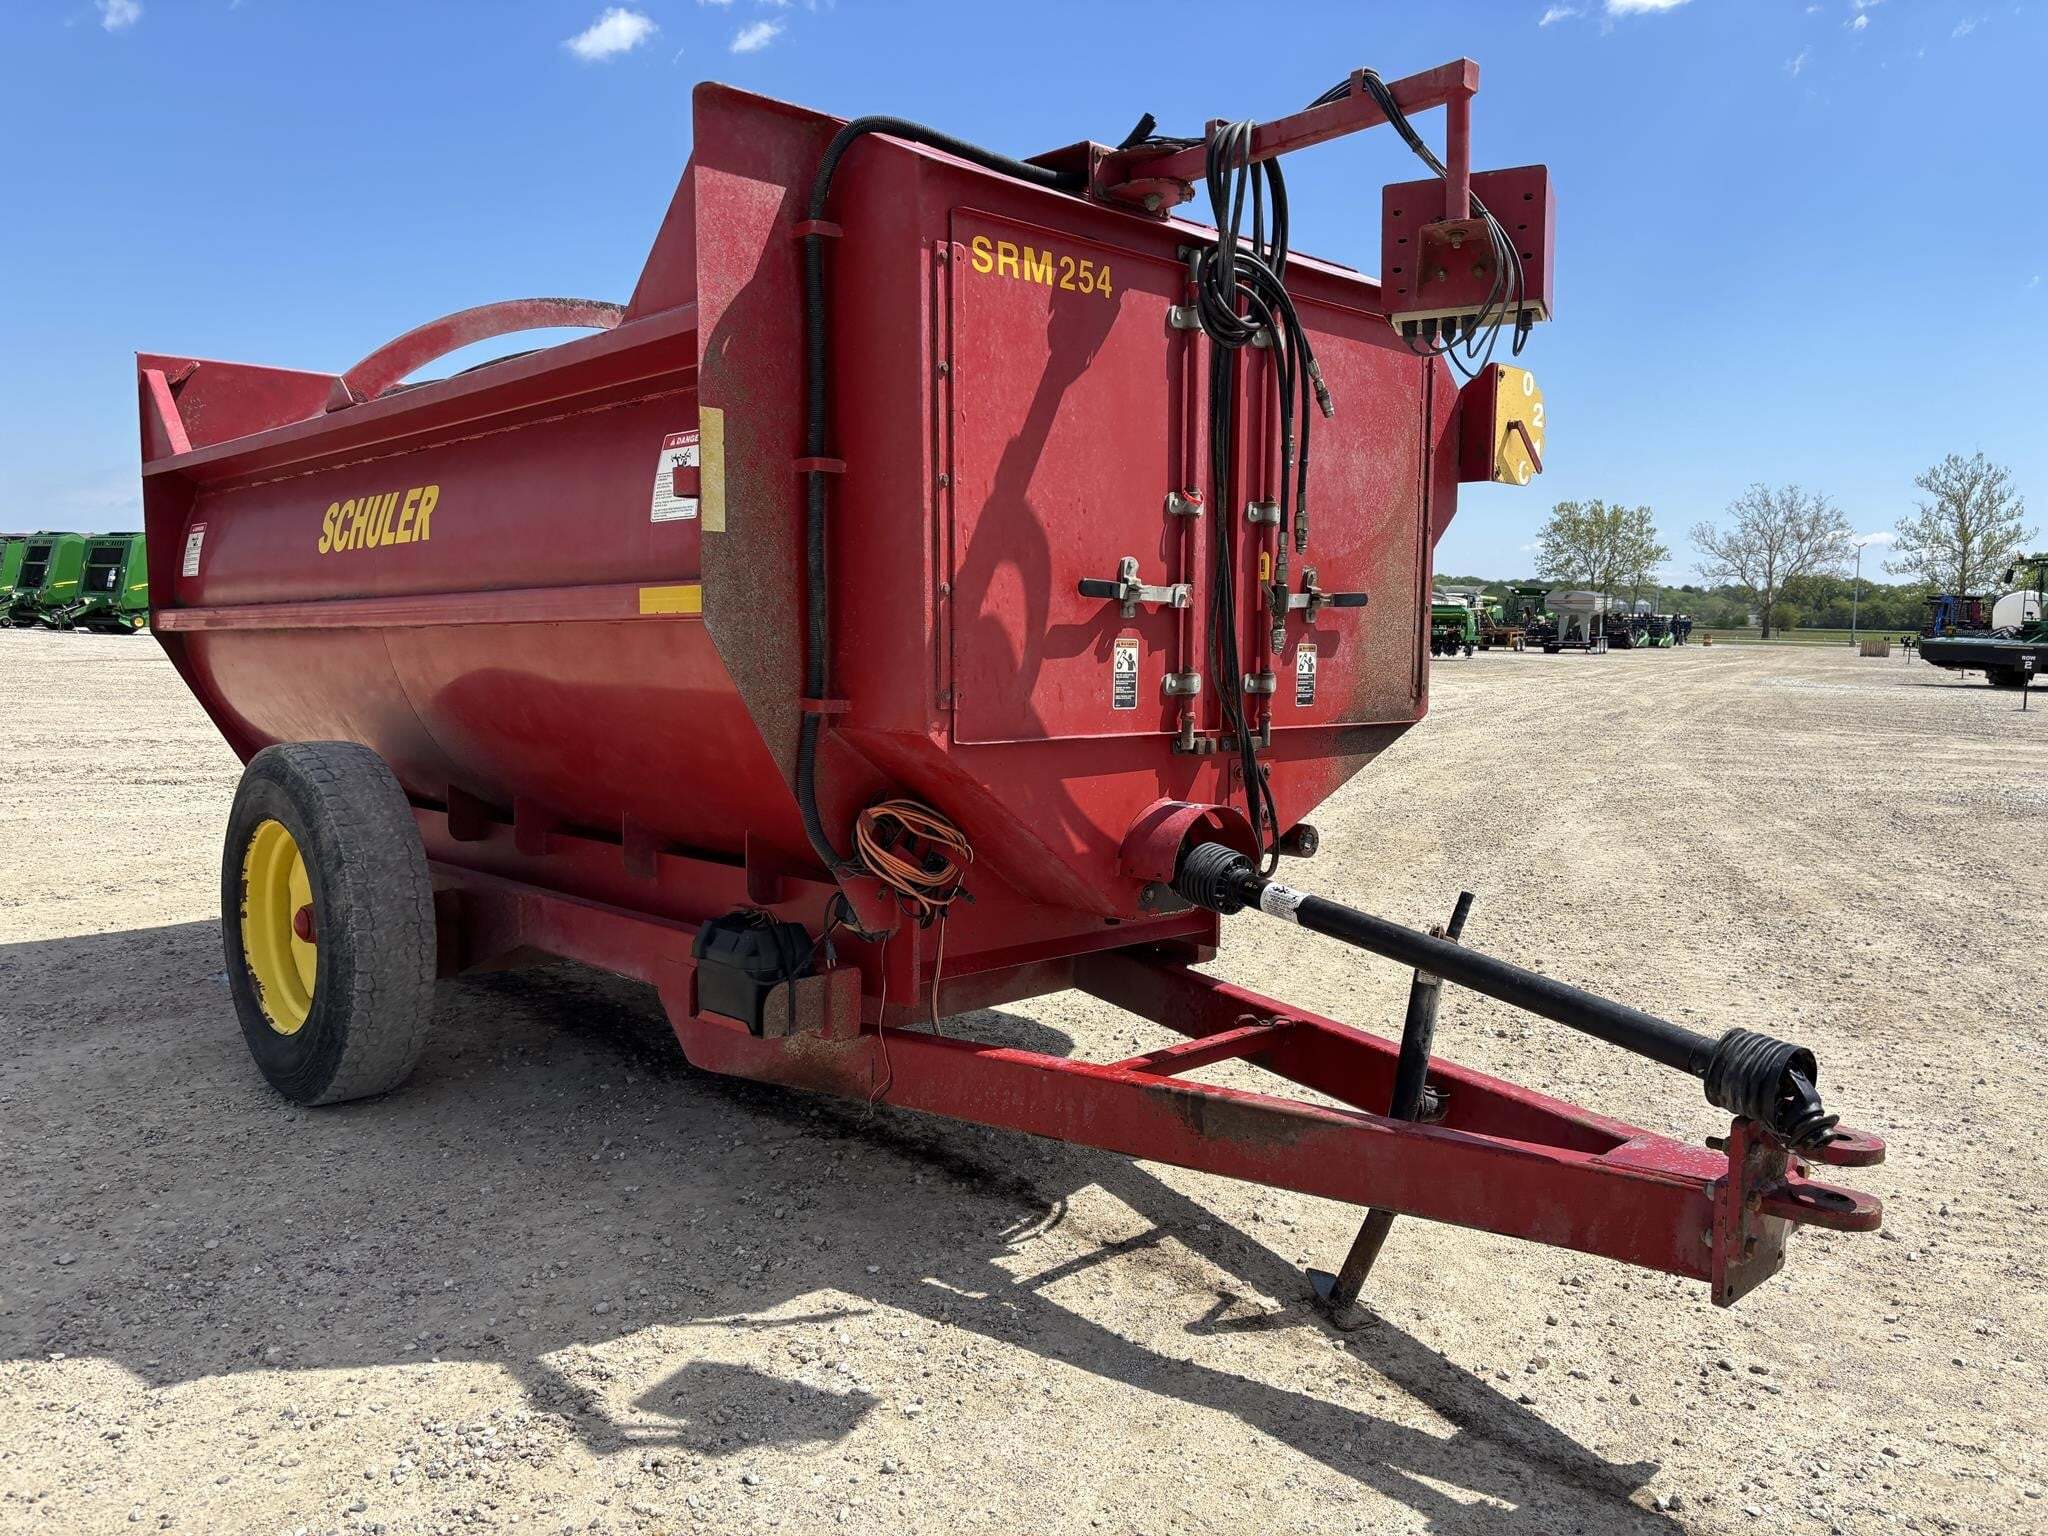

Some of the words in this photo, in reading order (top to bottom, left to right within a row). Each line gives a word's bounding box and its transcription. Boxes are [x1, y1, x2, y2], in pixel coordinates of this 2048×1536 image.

[1532, 403, 1544, 428] 2
[676, 433, 699, 446] DANGE
[318, 485, 440, 554] SCHULER
[2023, 661, 2033, 669] 2
